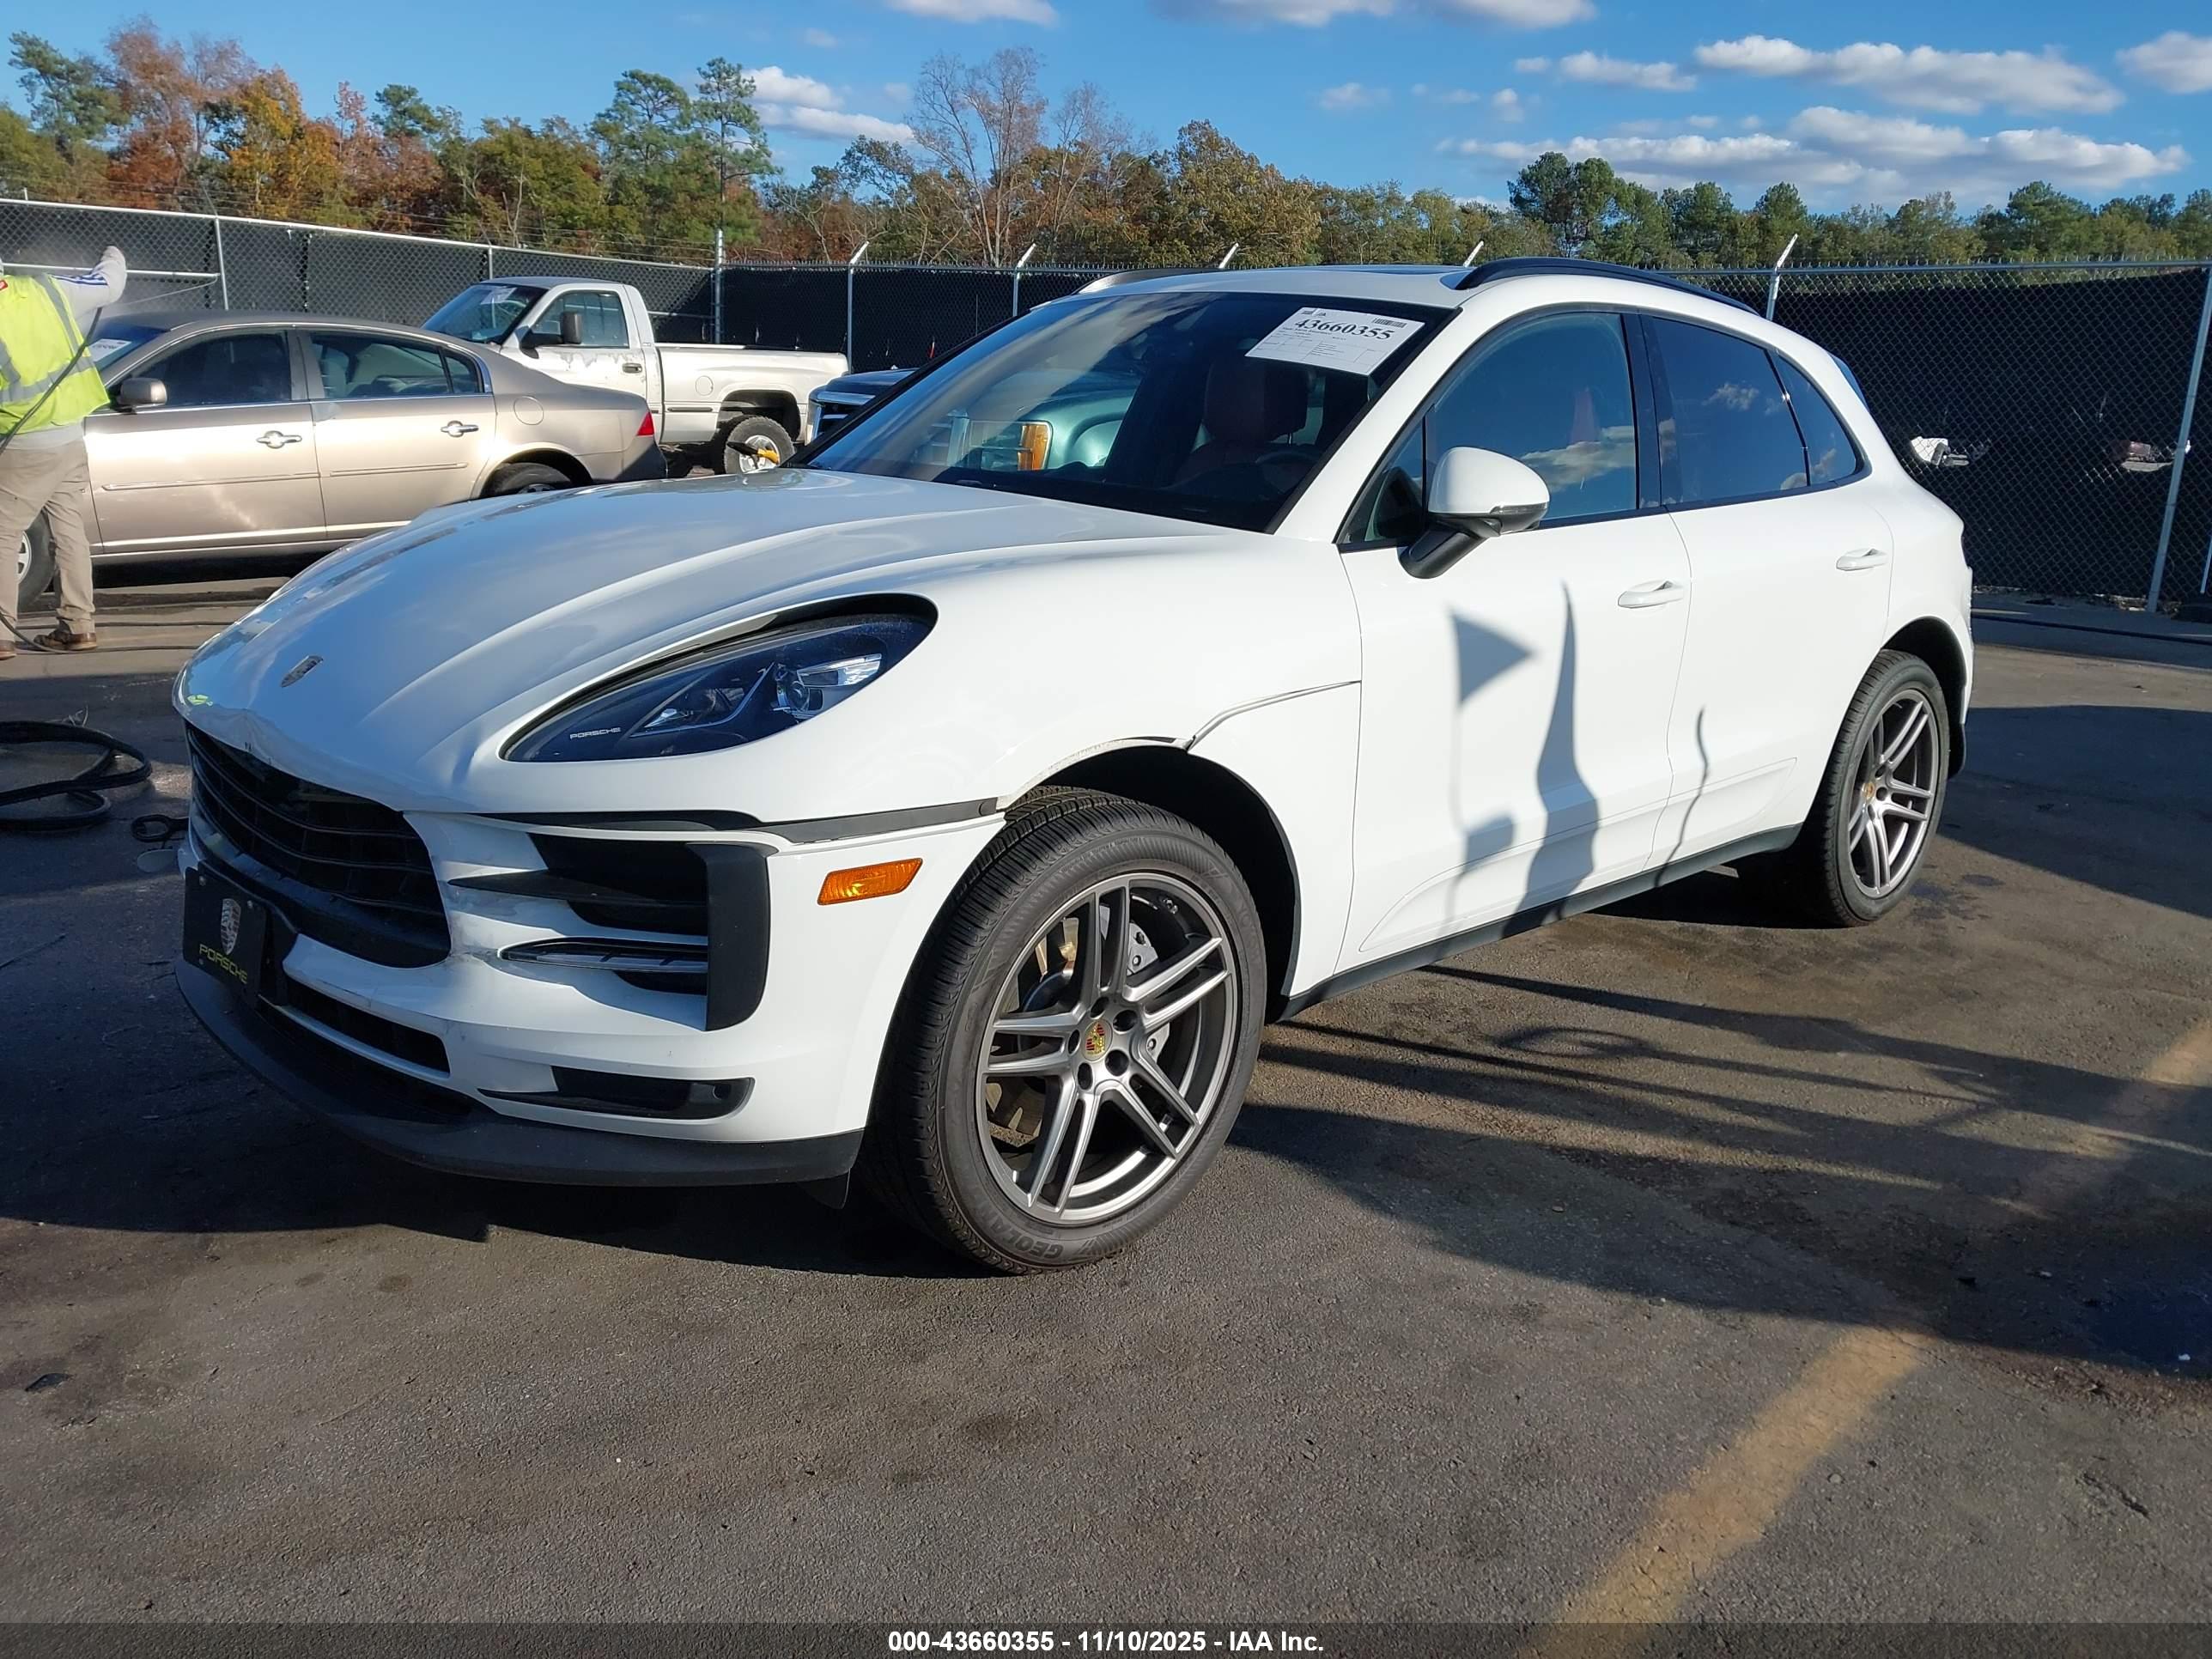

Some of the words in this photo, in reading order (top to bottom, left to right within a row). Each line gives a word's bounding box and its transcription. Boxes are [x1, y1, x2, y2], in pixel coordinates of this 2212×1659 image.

[1295, 319, 1395, 340] 43660355
[569, 726, 622, 739] PORSCHE
[198, 943, 248, 984] PORSCHE
